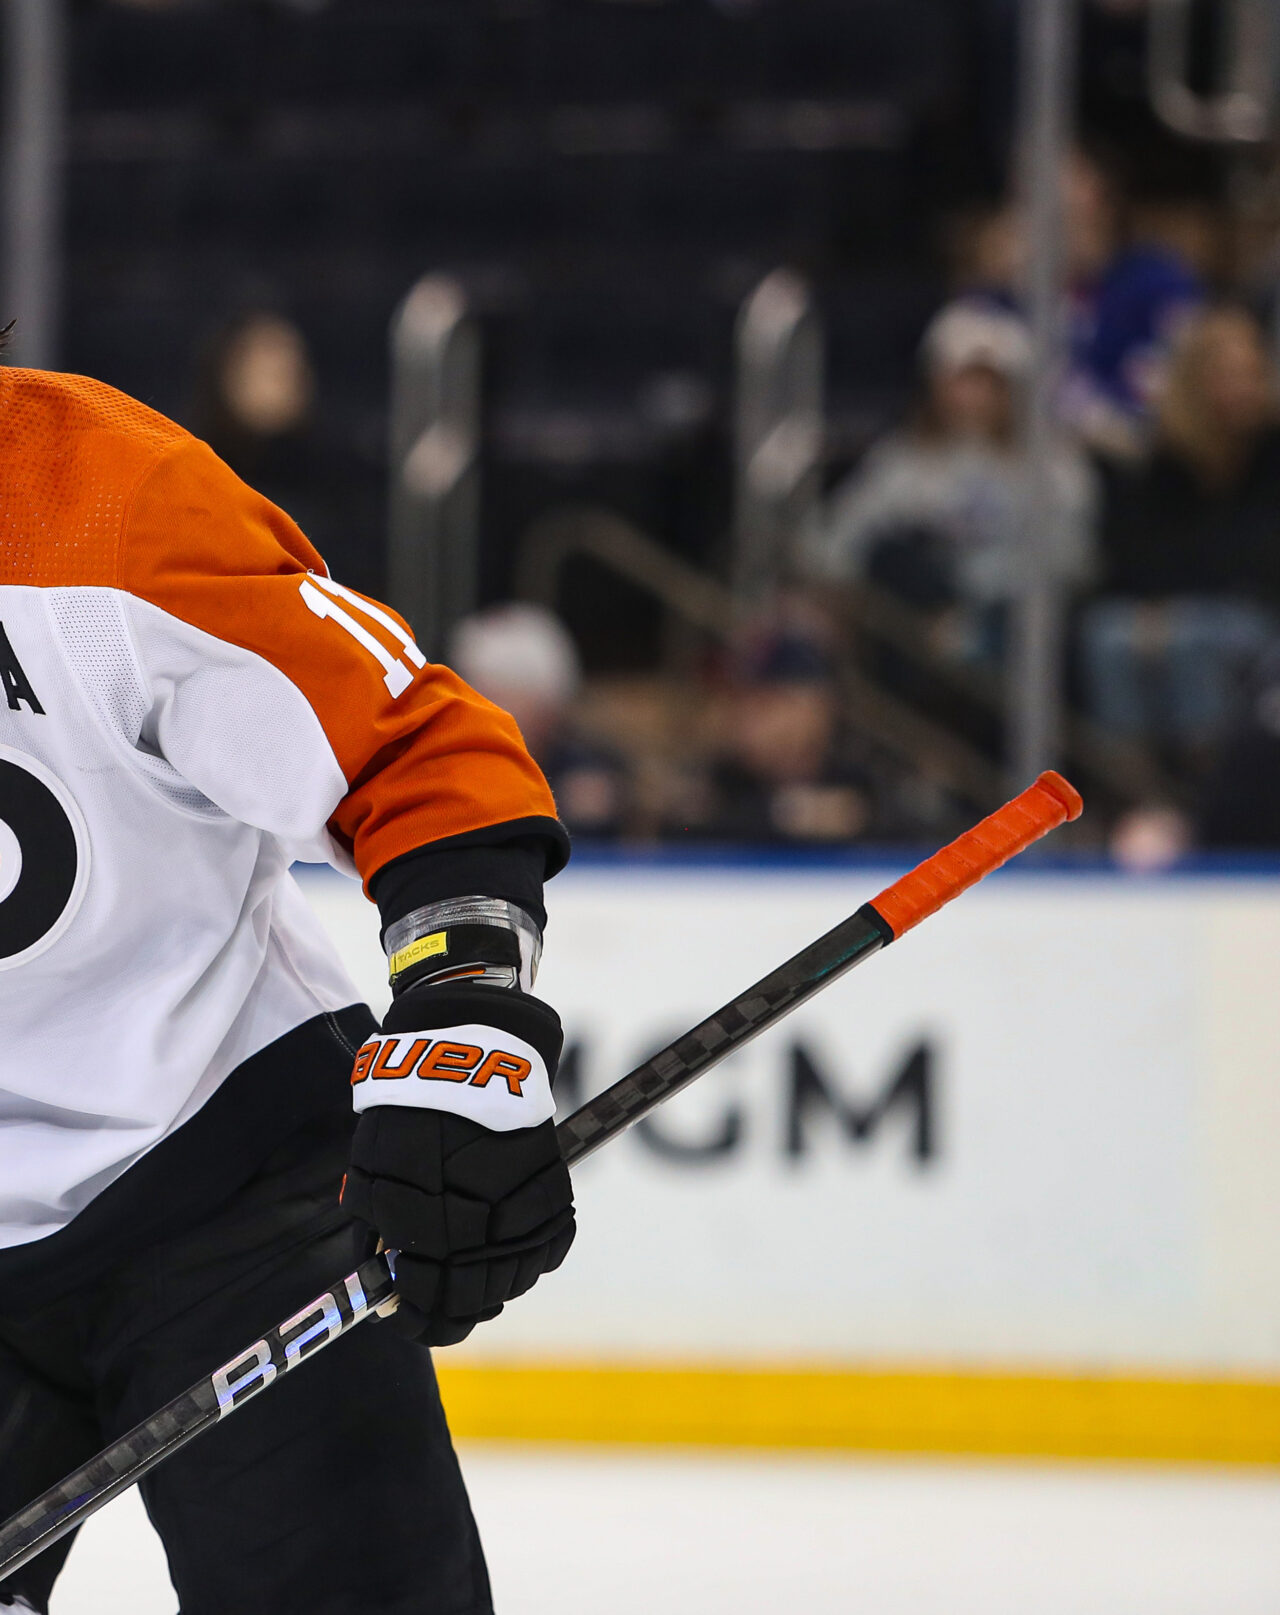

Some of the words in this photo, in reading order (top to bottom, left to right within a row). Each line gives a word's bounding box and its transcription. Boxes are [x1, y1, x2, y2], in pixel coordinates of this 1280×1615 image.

[298, 572, 427, 700] 11
[397, 939, 440, 963] TACKS
[351, 1038, 532, 1098] AUER
